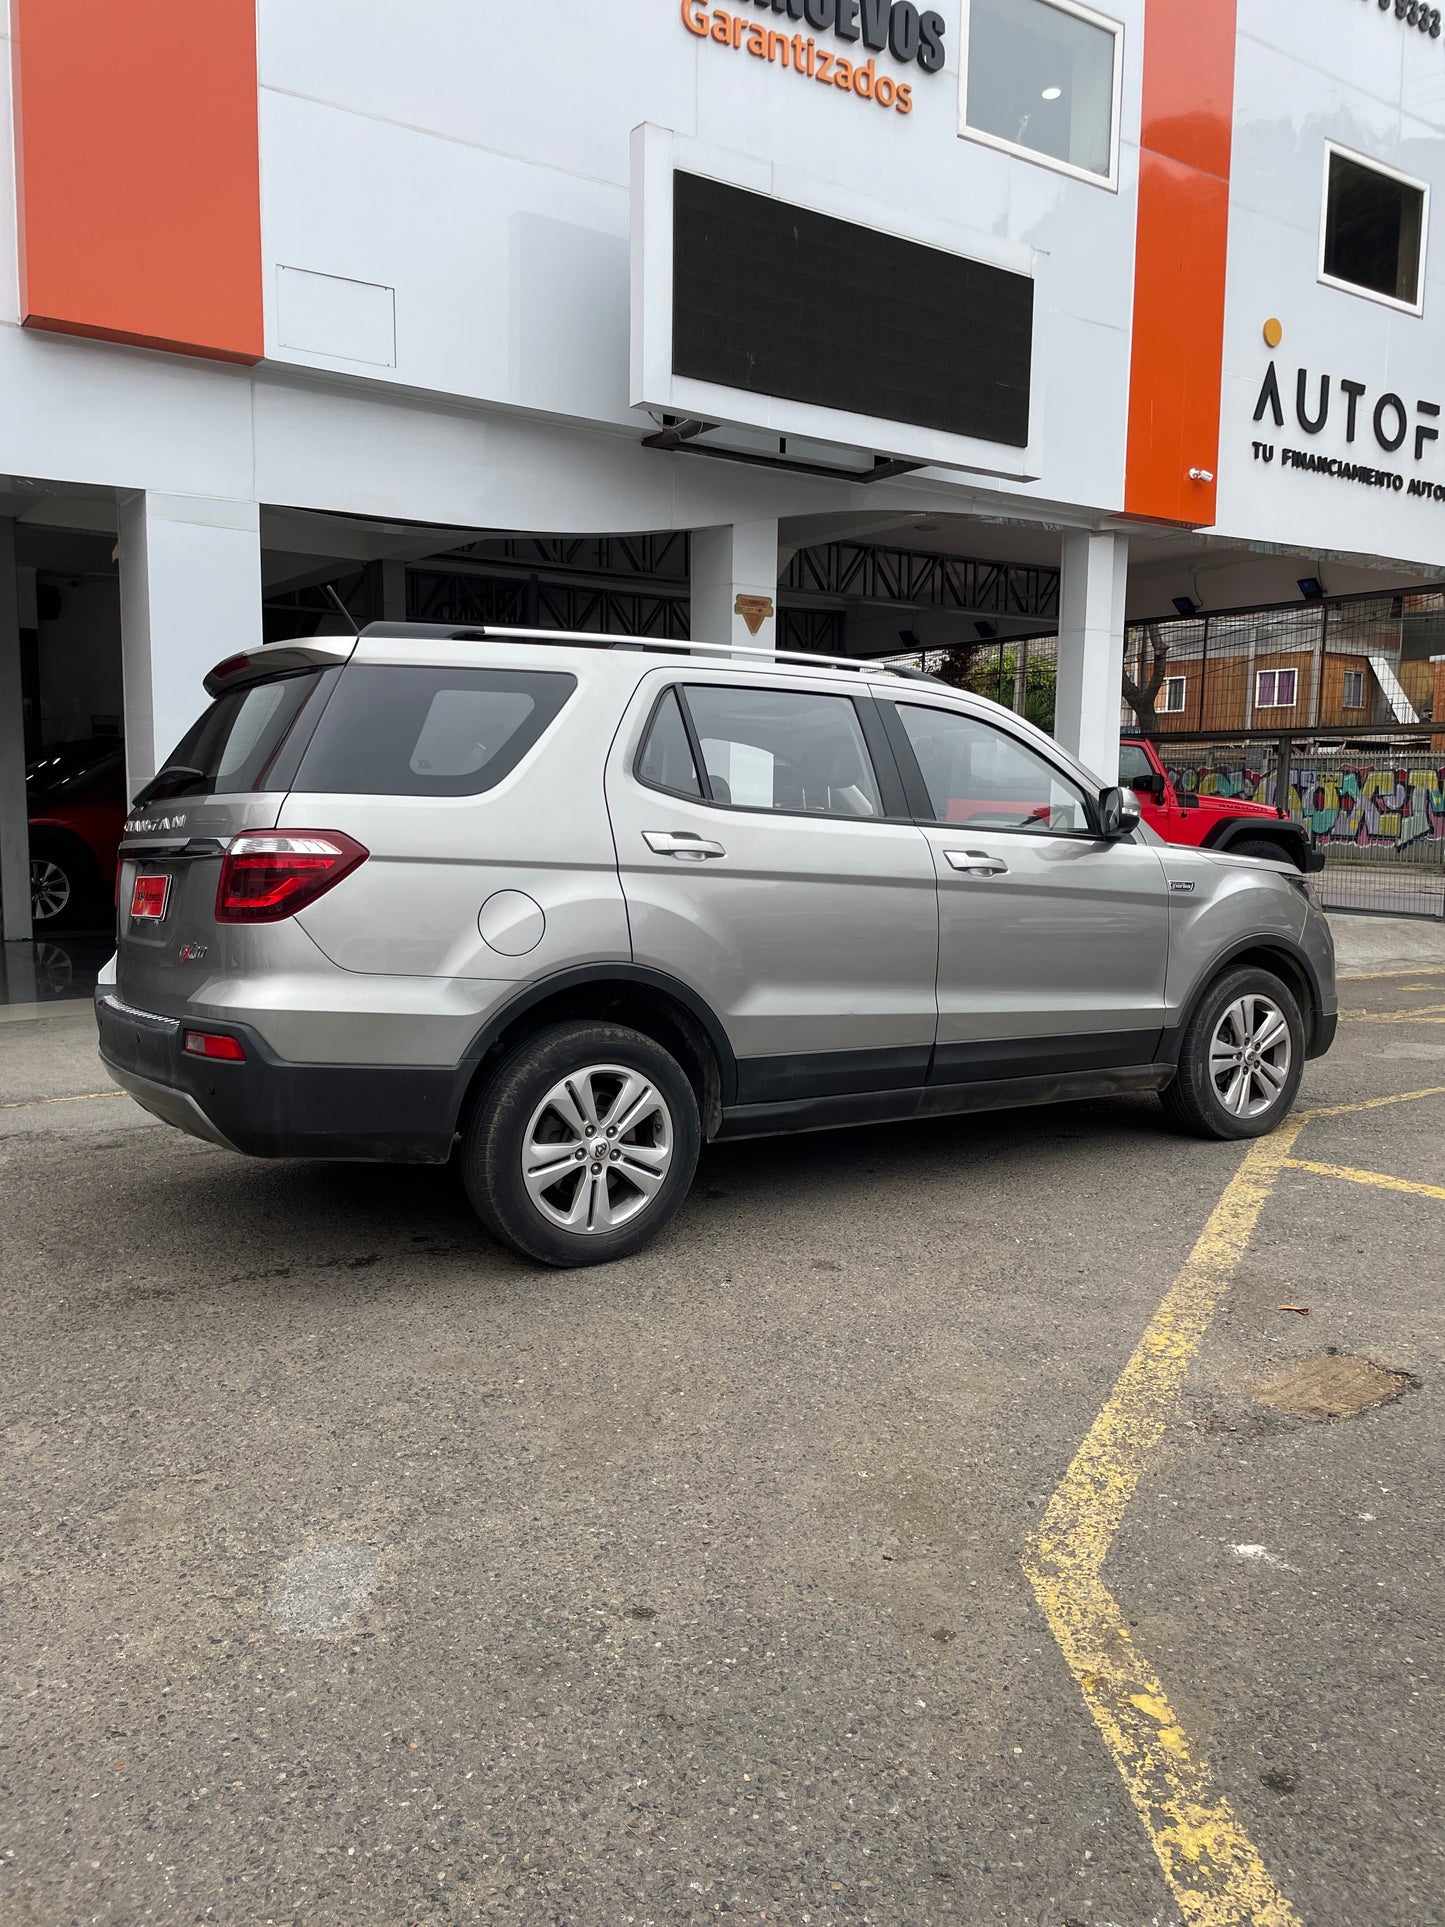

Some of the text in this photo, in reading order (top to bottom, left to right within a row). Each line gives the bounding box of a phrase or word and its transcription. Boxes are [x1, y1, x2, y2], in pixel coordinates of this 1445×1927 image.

[681, 0, 913, 114] Garantizados
[1253, 361, 1440, 460] AUTOF
[1252, 441, 1274, 462] TU
[1281, 448, 1404, 492] FINANCIAMIENTO
